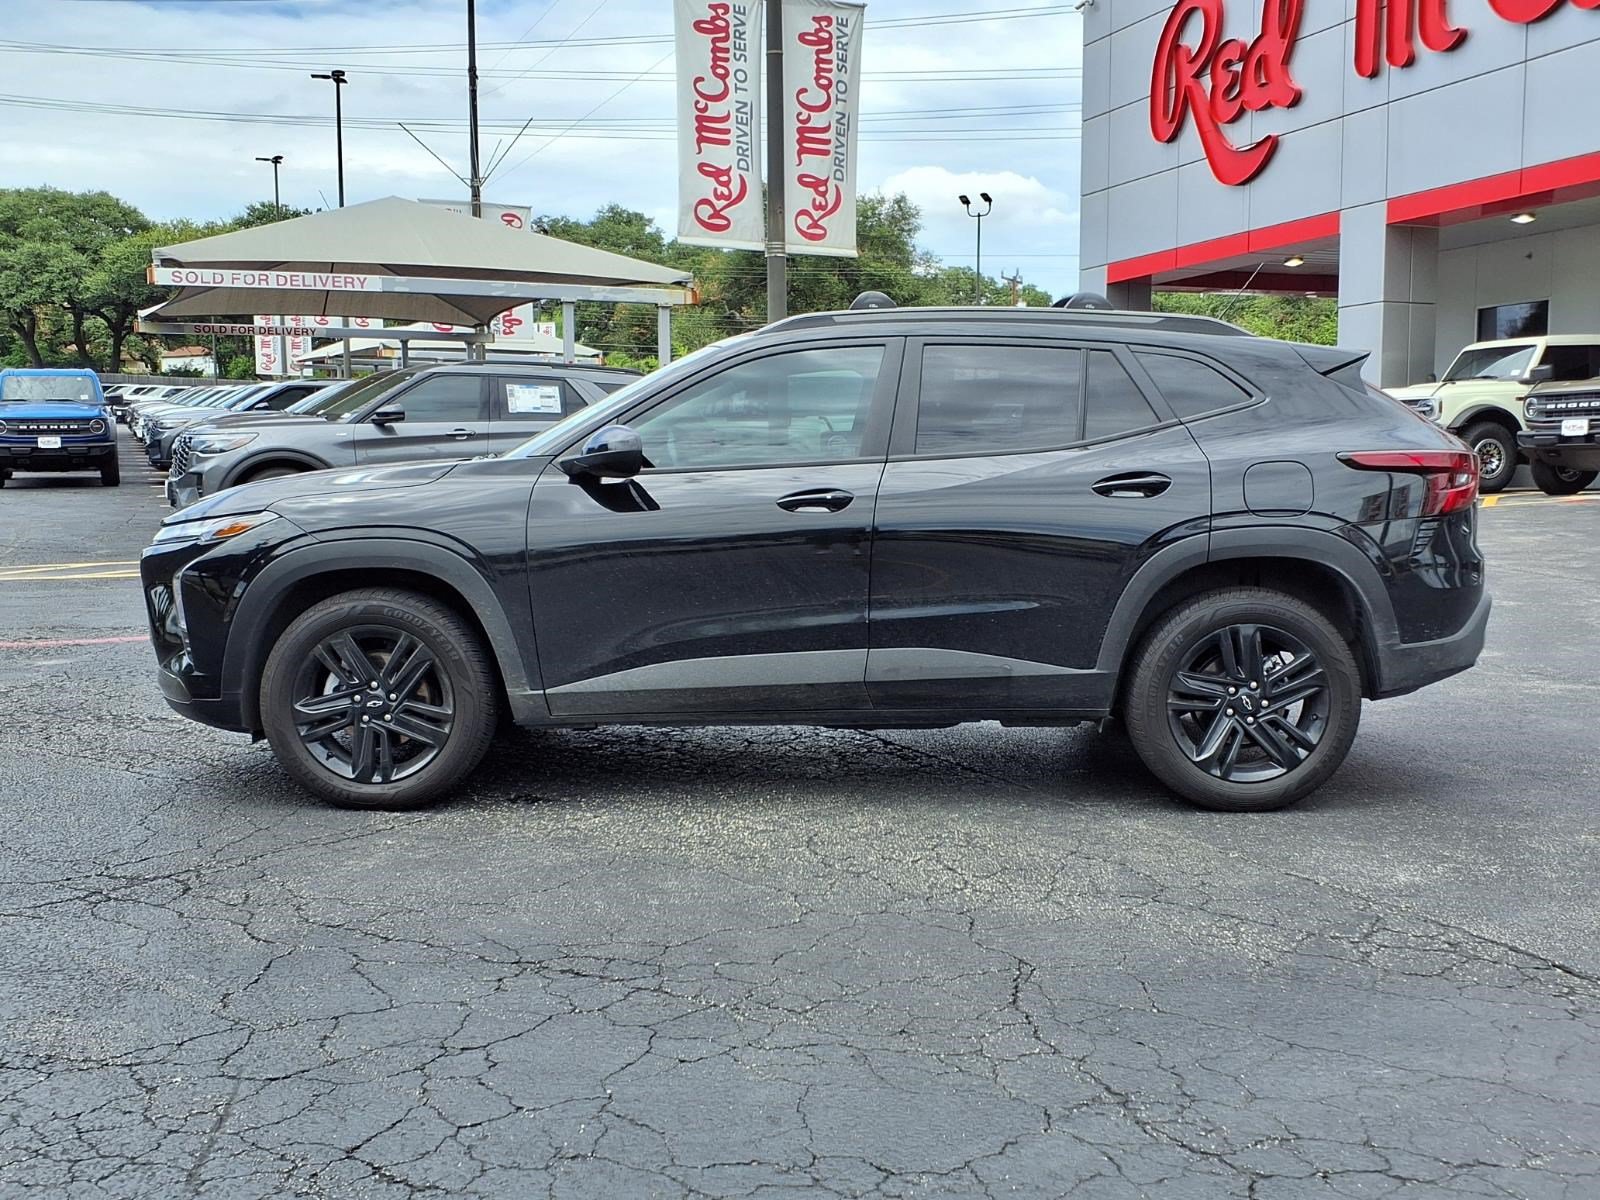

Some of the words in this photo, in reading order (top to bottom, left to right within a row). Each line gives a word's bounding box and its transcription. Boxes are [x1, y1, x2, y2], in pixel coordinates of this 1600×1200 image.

[733, 3, 748, 64] SERVE
[836, 16, 849, 75] SERVE
[733, 68, 748, 95] TO
[835, 79, 848, 104] TO
[1150, 0, 1304, 187] Red
[736, 100, 750, 173] DRIVEN
[833, 111, 847, 183] DRIVEN
[693, 162, 748, 233] Red
[794, 173, 842, 242] Red
[171, 270, 225, 285] SOLD
[231, 273, 270, 286] FOR
[276, 274, 368, 289] DELIVERY
[193, 324, 227, 335] SOLD
[230, 325, 255, 335] FOR
[259, 326, 317, 336] DELIVERY
